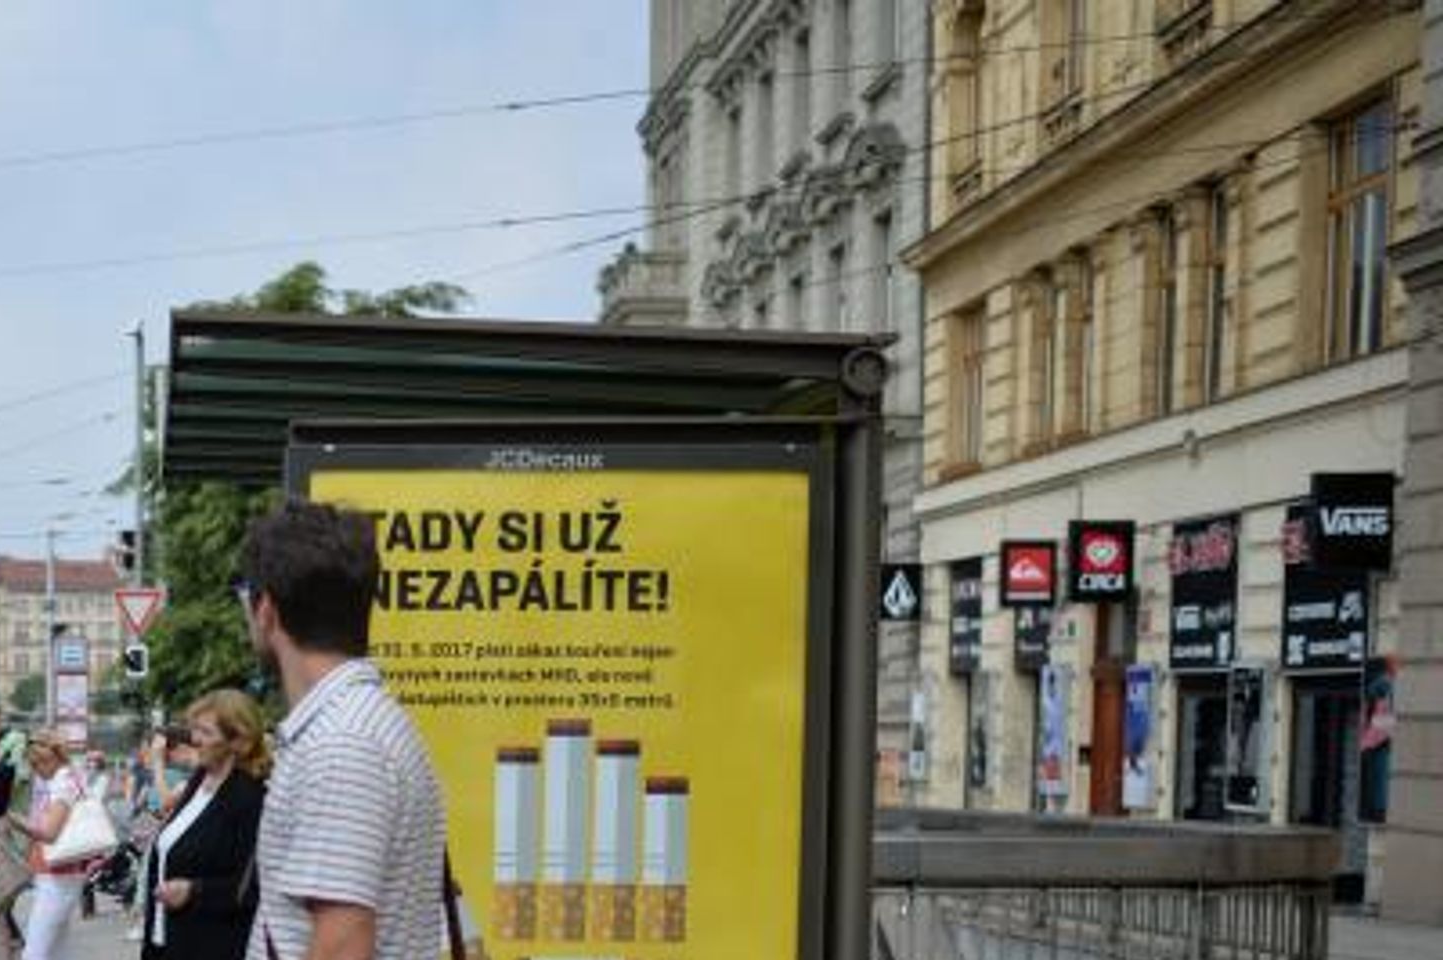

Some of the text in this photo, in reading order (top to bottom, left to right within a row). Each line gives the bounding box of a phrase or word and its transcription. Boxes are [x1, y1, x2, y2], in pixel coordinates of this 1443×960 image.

[484, 450, 604, 470] JCDecaux
[361, 499, 622, 553] TADY SI UŽ
[1320, 506, 1389, 536] VANS
[367, 558, 668, 611] NEZAPÁLÍTE!
[429, 643, 474, 658] 2017
